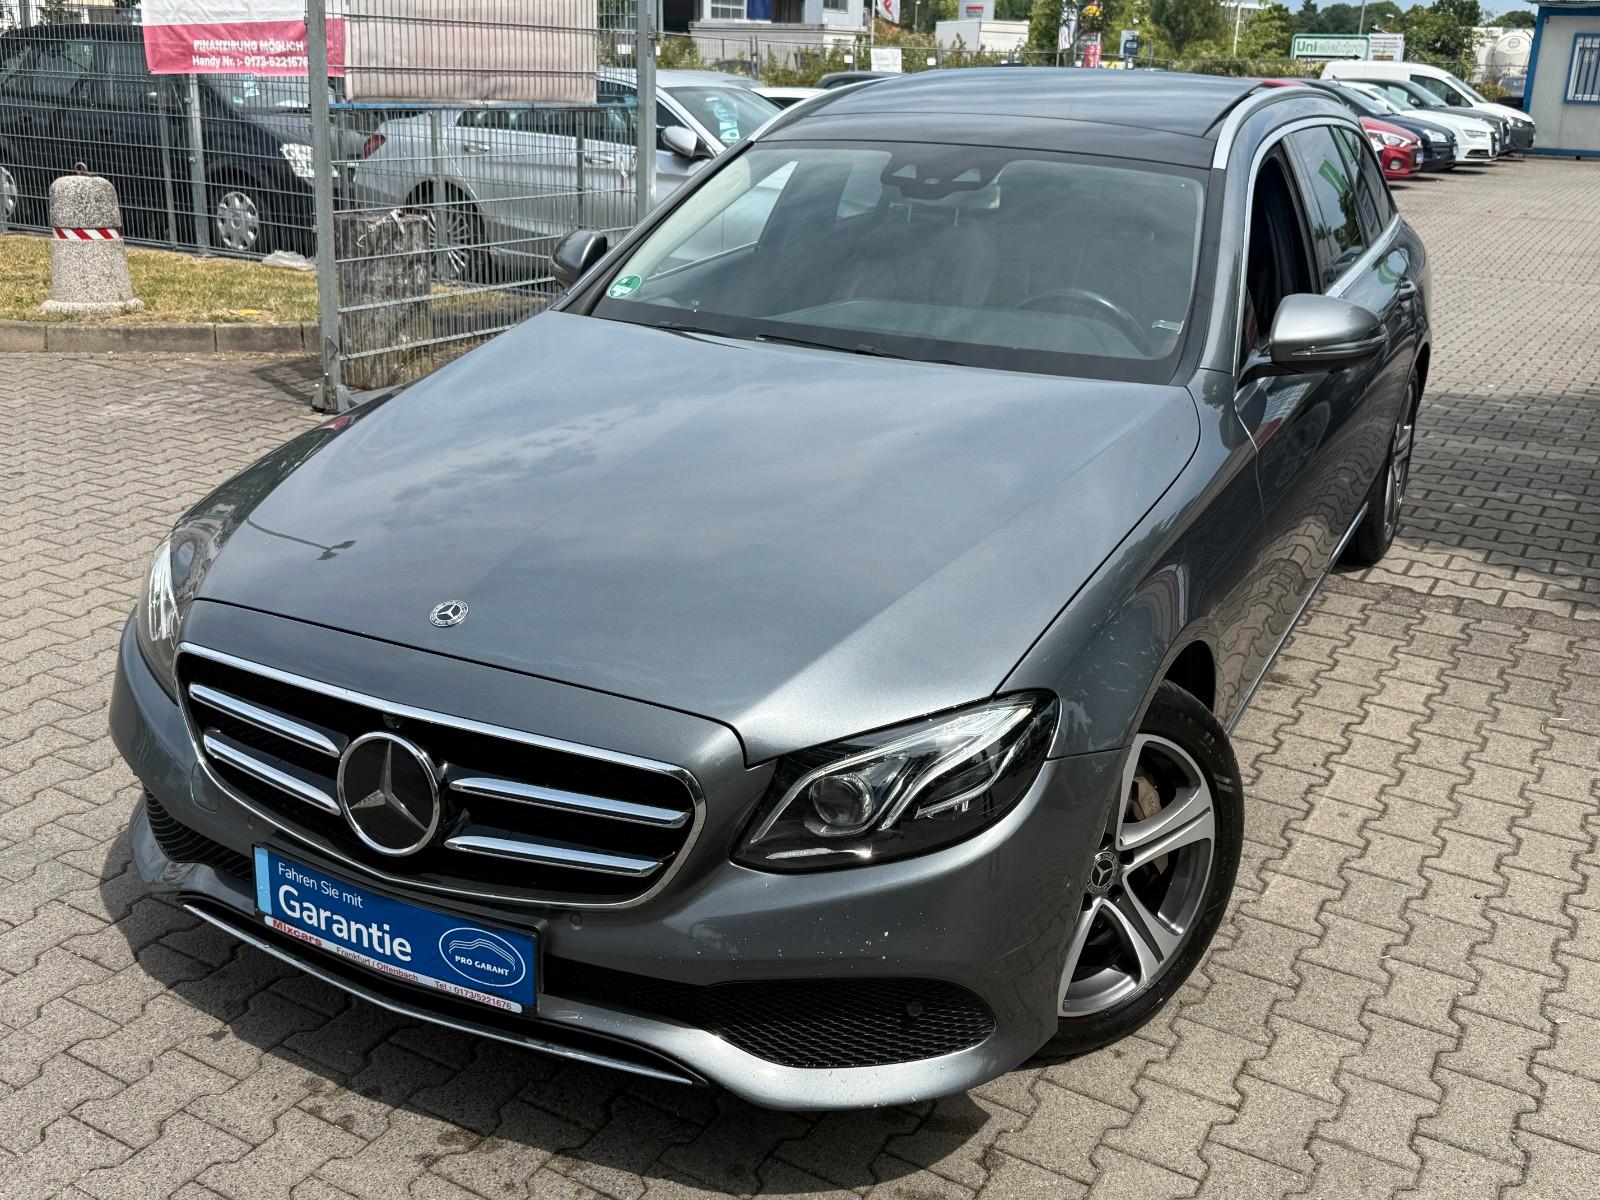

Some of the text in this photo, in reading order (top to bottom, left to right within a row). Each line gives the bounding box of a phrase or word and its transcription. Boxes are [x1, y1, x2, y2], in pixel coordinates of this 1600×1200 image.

[260, 38, 304, 51] MÖGLICH
[192, 55, 220, 69] Handy
[278, 862, 363, 909] Fahren Sie mit
[272, 918, 322, 947] Mixcars
[278, 884, 412, 962] Garantie
[336, 946, 371, 966] Frankfurt
[377, 962, 418, 983] Offenbach
[455, 955, 509, 976] PRO GARANT
[454, 986, 512, 1010] 0173/5221676
